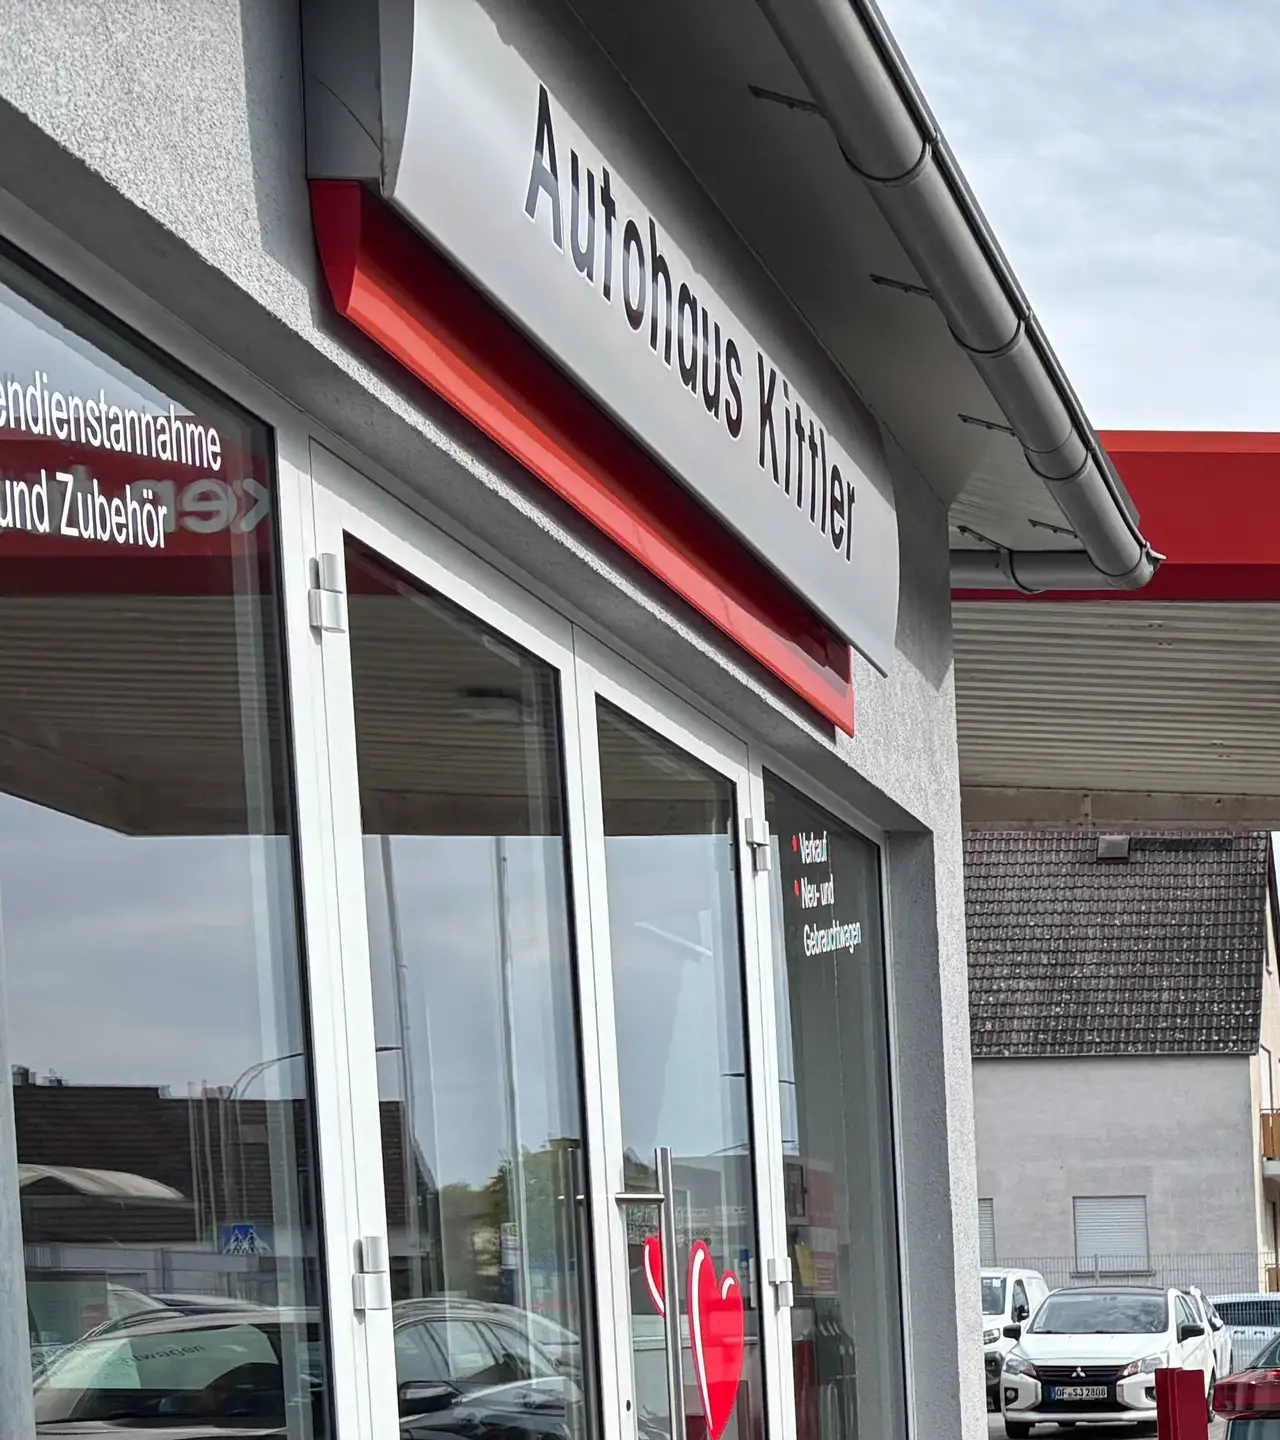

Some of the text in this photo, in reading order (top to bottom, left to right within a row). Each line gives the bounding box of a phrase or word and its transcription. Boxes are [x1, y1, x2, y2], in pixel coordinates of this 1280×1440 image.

[524, 83, 856, 562] Autohaus Kittler
[56, 472, 167, 548] Zubehör
[799, 831, 827, 864] Verkauf
